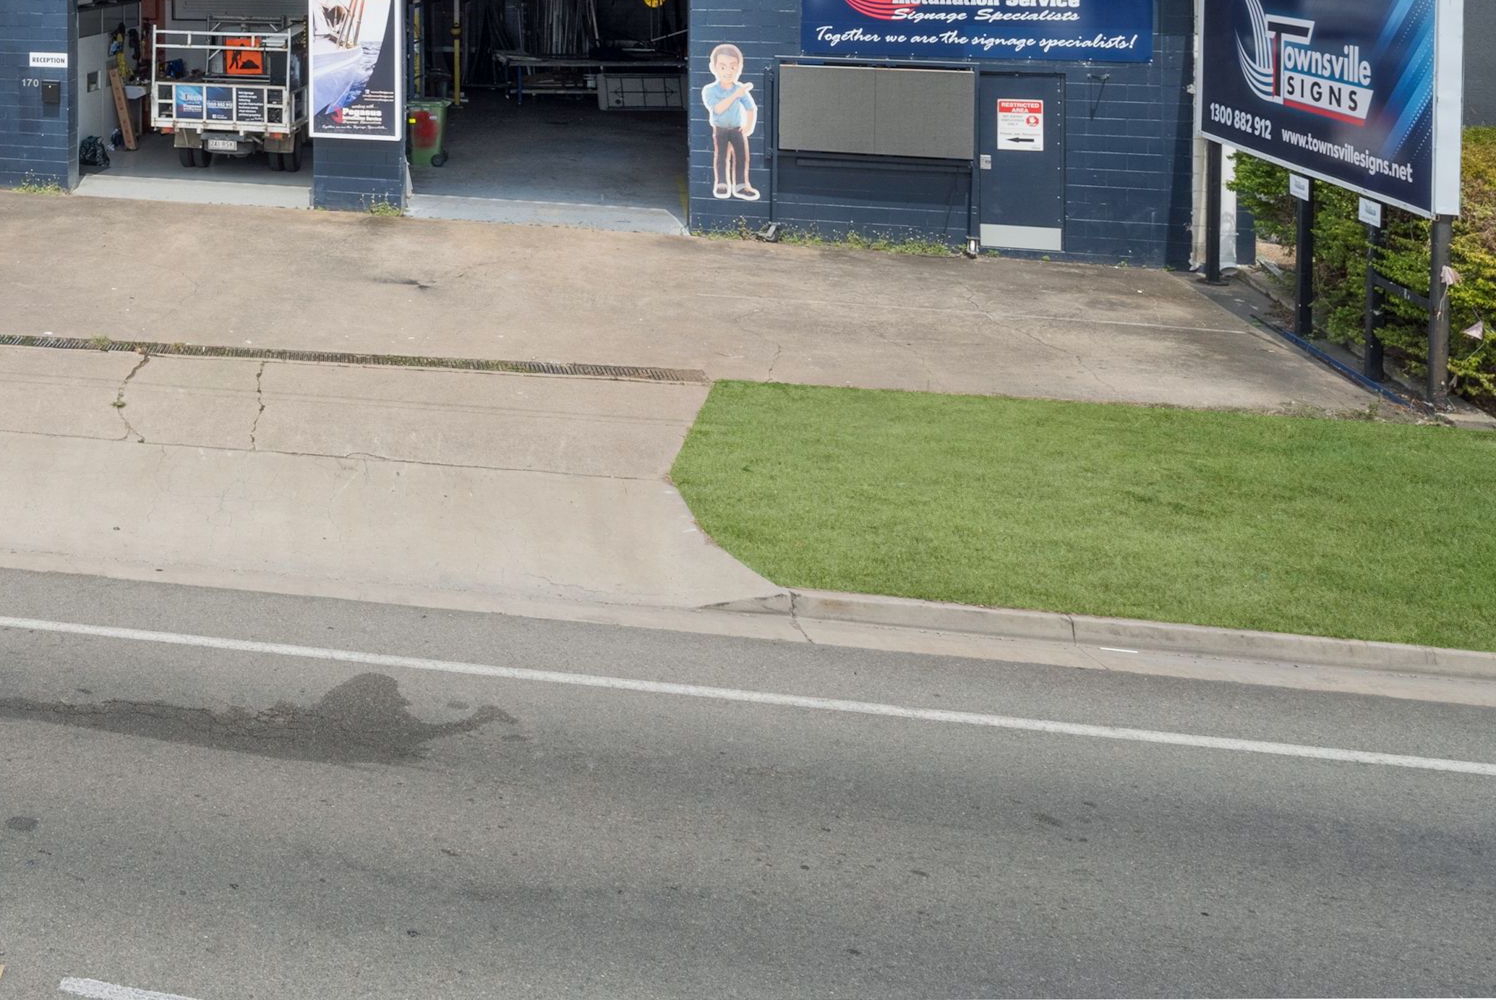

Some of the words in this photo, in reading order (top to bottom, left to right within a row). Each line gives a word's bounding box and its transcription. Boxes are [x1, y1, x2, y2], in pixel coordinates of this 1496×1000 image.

[891, 8, 968, 23] Signage
[974, 8, 1080, 23] Specialists
[816, 25, 881, 46] Together
[885, 35, 907, 43] we
[910, 35, 939, 44] are
[939, 30, 968, 45] the
[971, 33, 1036, 51] signage
[1039, 34, 1138, 52] specialists!
[1265, 14, 1371, 105] Townsville
[22, 78, 39, 87] 170
[1286, 75, 1358, 112] SIGNS
[343, 107, 382, 118] Pegasus
[1209, 102, 1232, 126] 1300
[1234, 110, 1253, 134] 882
[1254, 117, 1272, 140] 912
[1282, 128, 1413, 183] www.townsvillesigns.net
